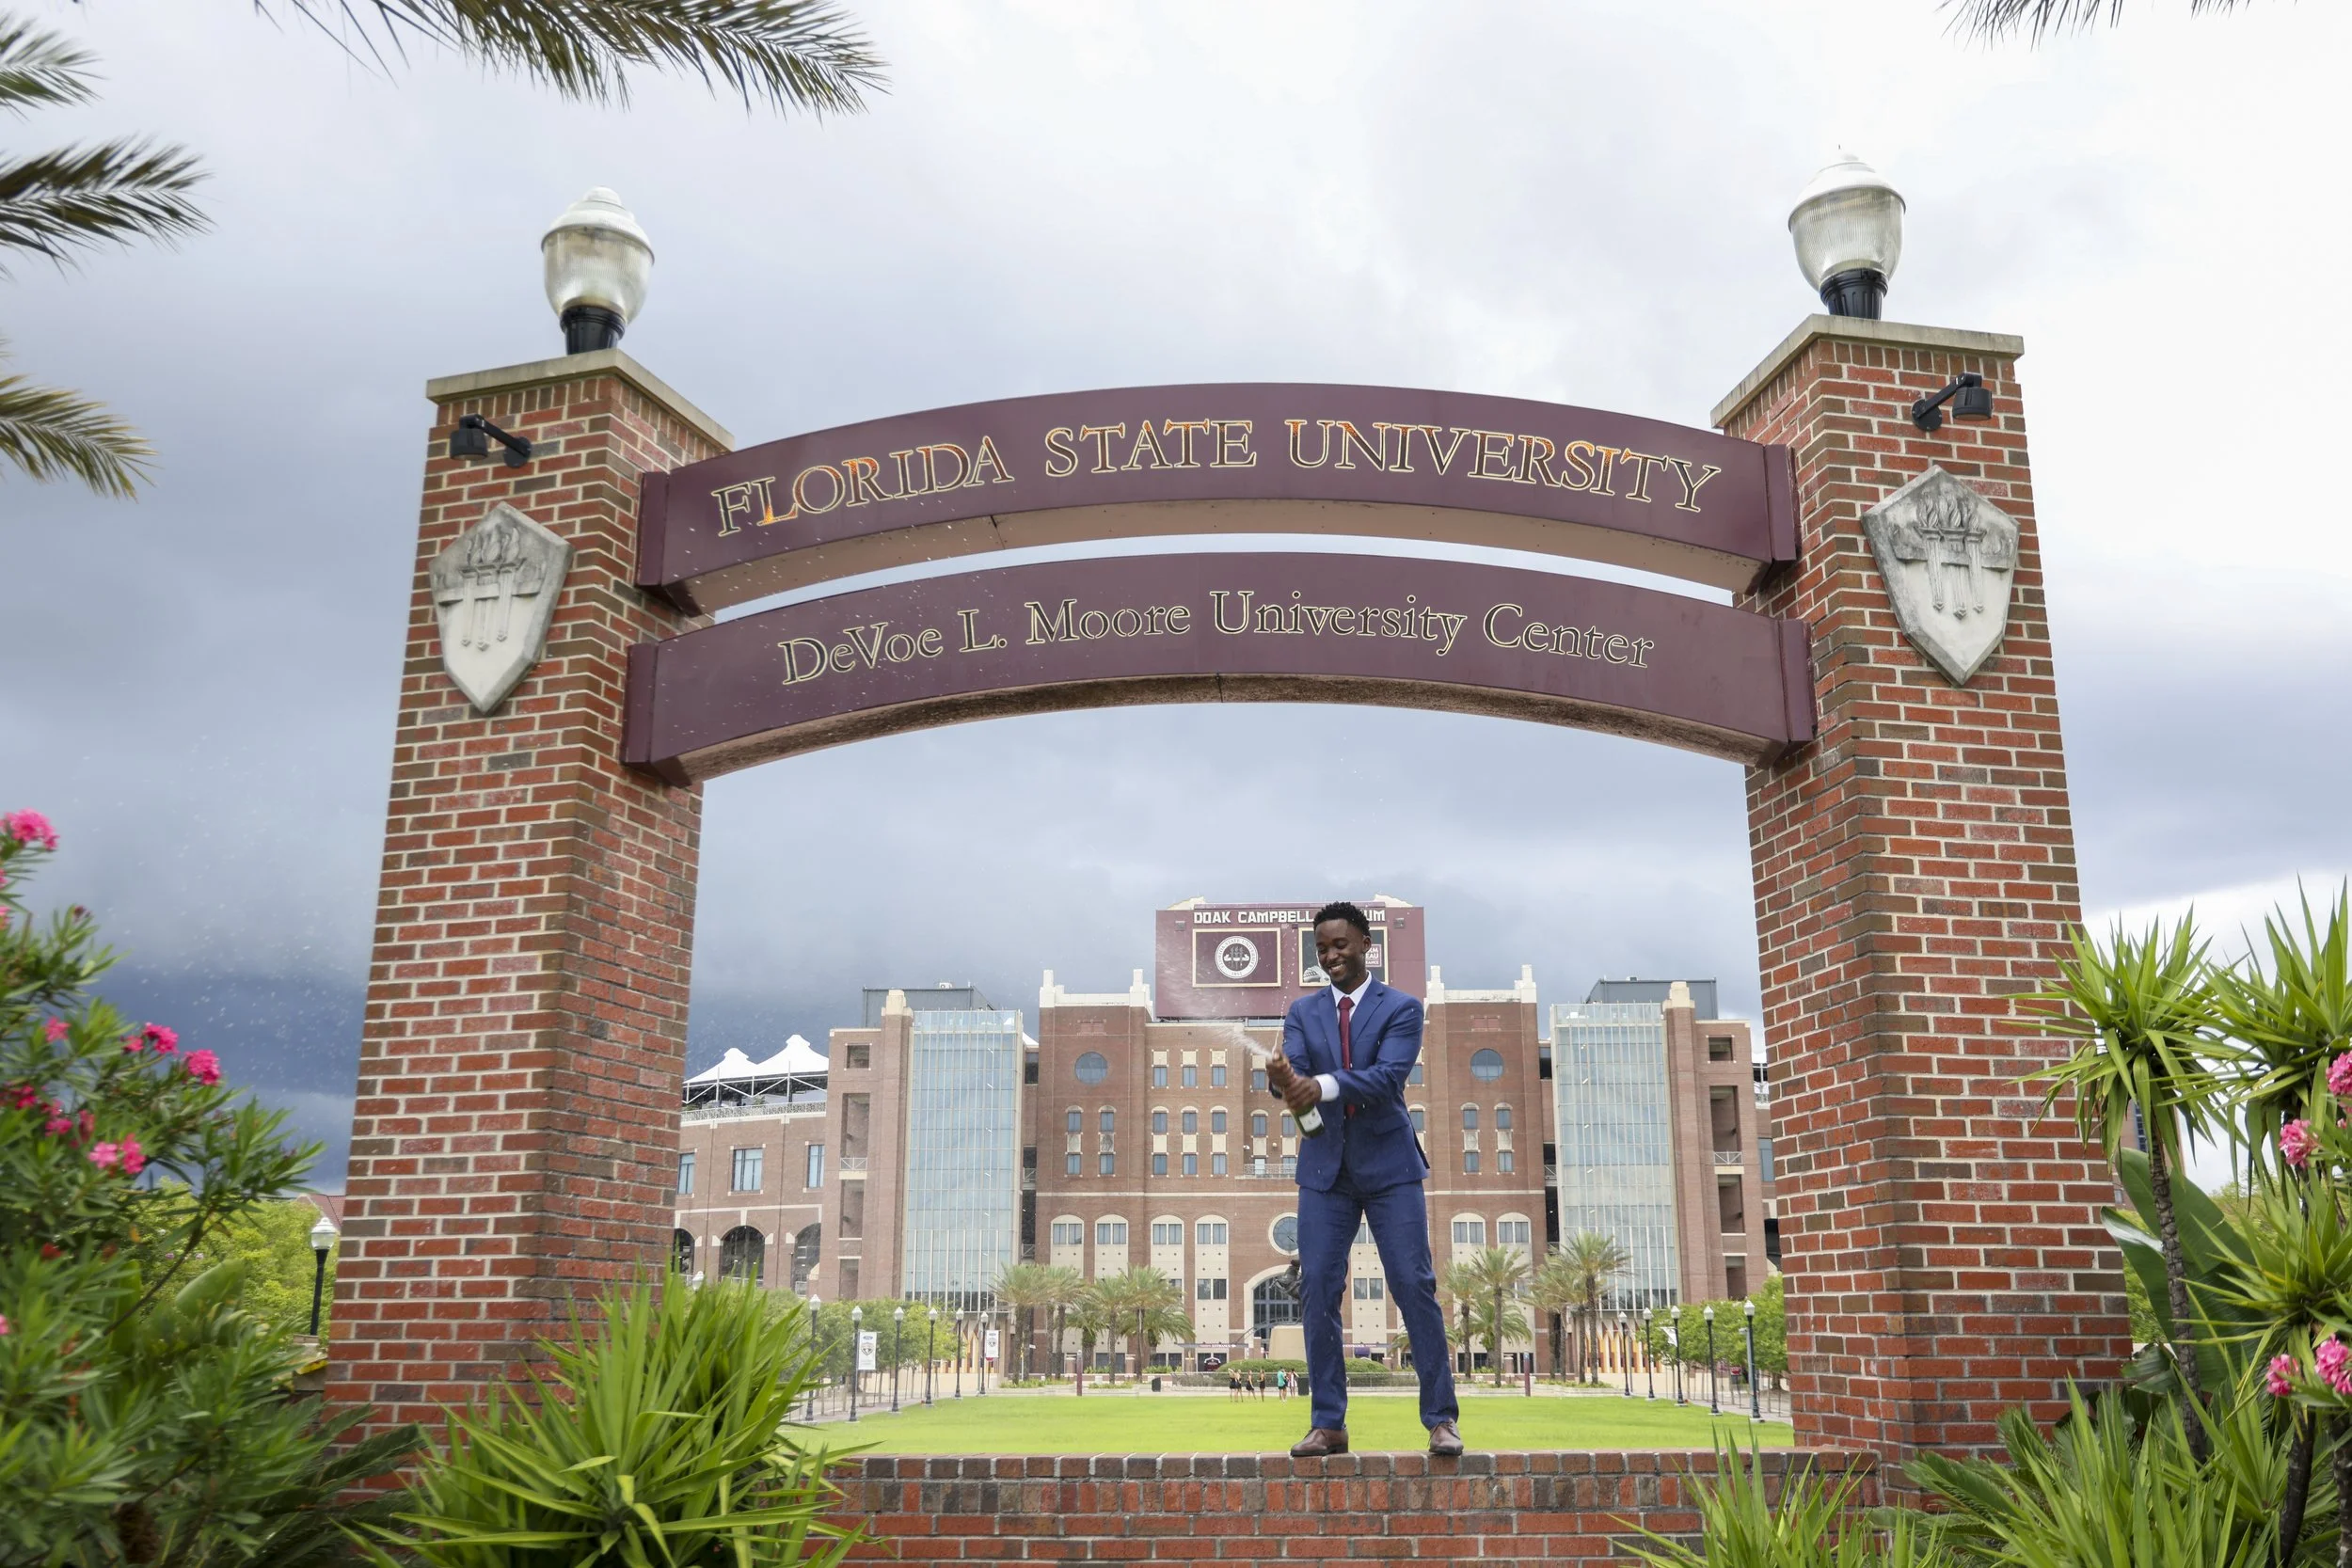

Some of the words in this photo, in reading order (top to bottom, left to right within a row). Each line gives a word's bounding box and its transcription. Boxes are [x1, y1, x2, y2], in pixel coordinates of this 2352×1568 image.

[711, 436, 1014, 537] FLORIDA
[1045, 419, 1257, 477] STATE
[1284, 420, 1721, 513] UNIVERSITY
[778, 622, 944, 685] DeVoe
[958, 609, 1008, 653] L.
[1025, 598, 1191, 644] Moore
[1209, 591, 1468, 657] University
[1483, 603, 1655, 669] Center
[1194, 911, 1232, 924] DOAK
[1238, 910, 1314, 924] CAMPBELL
